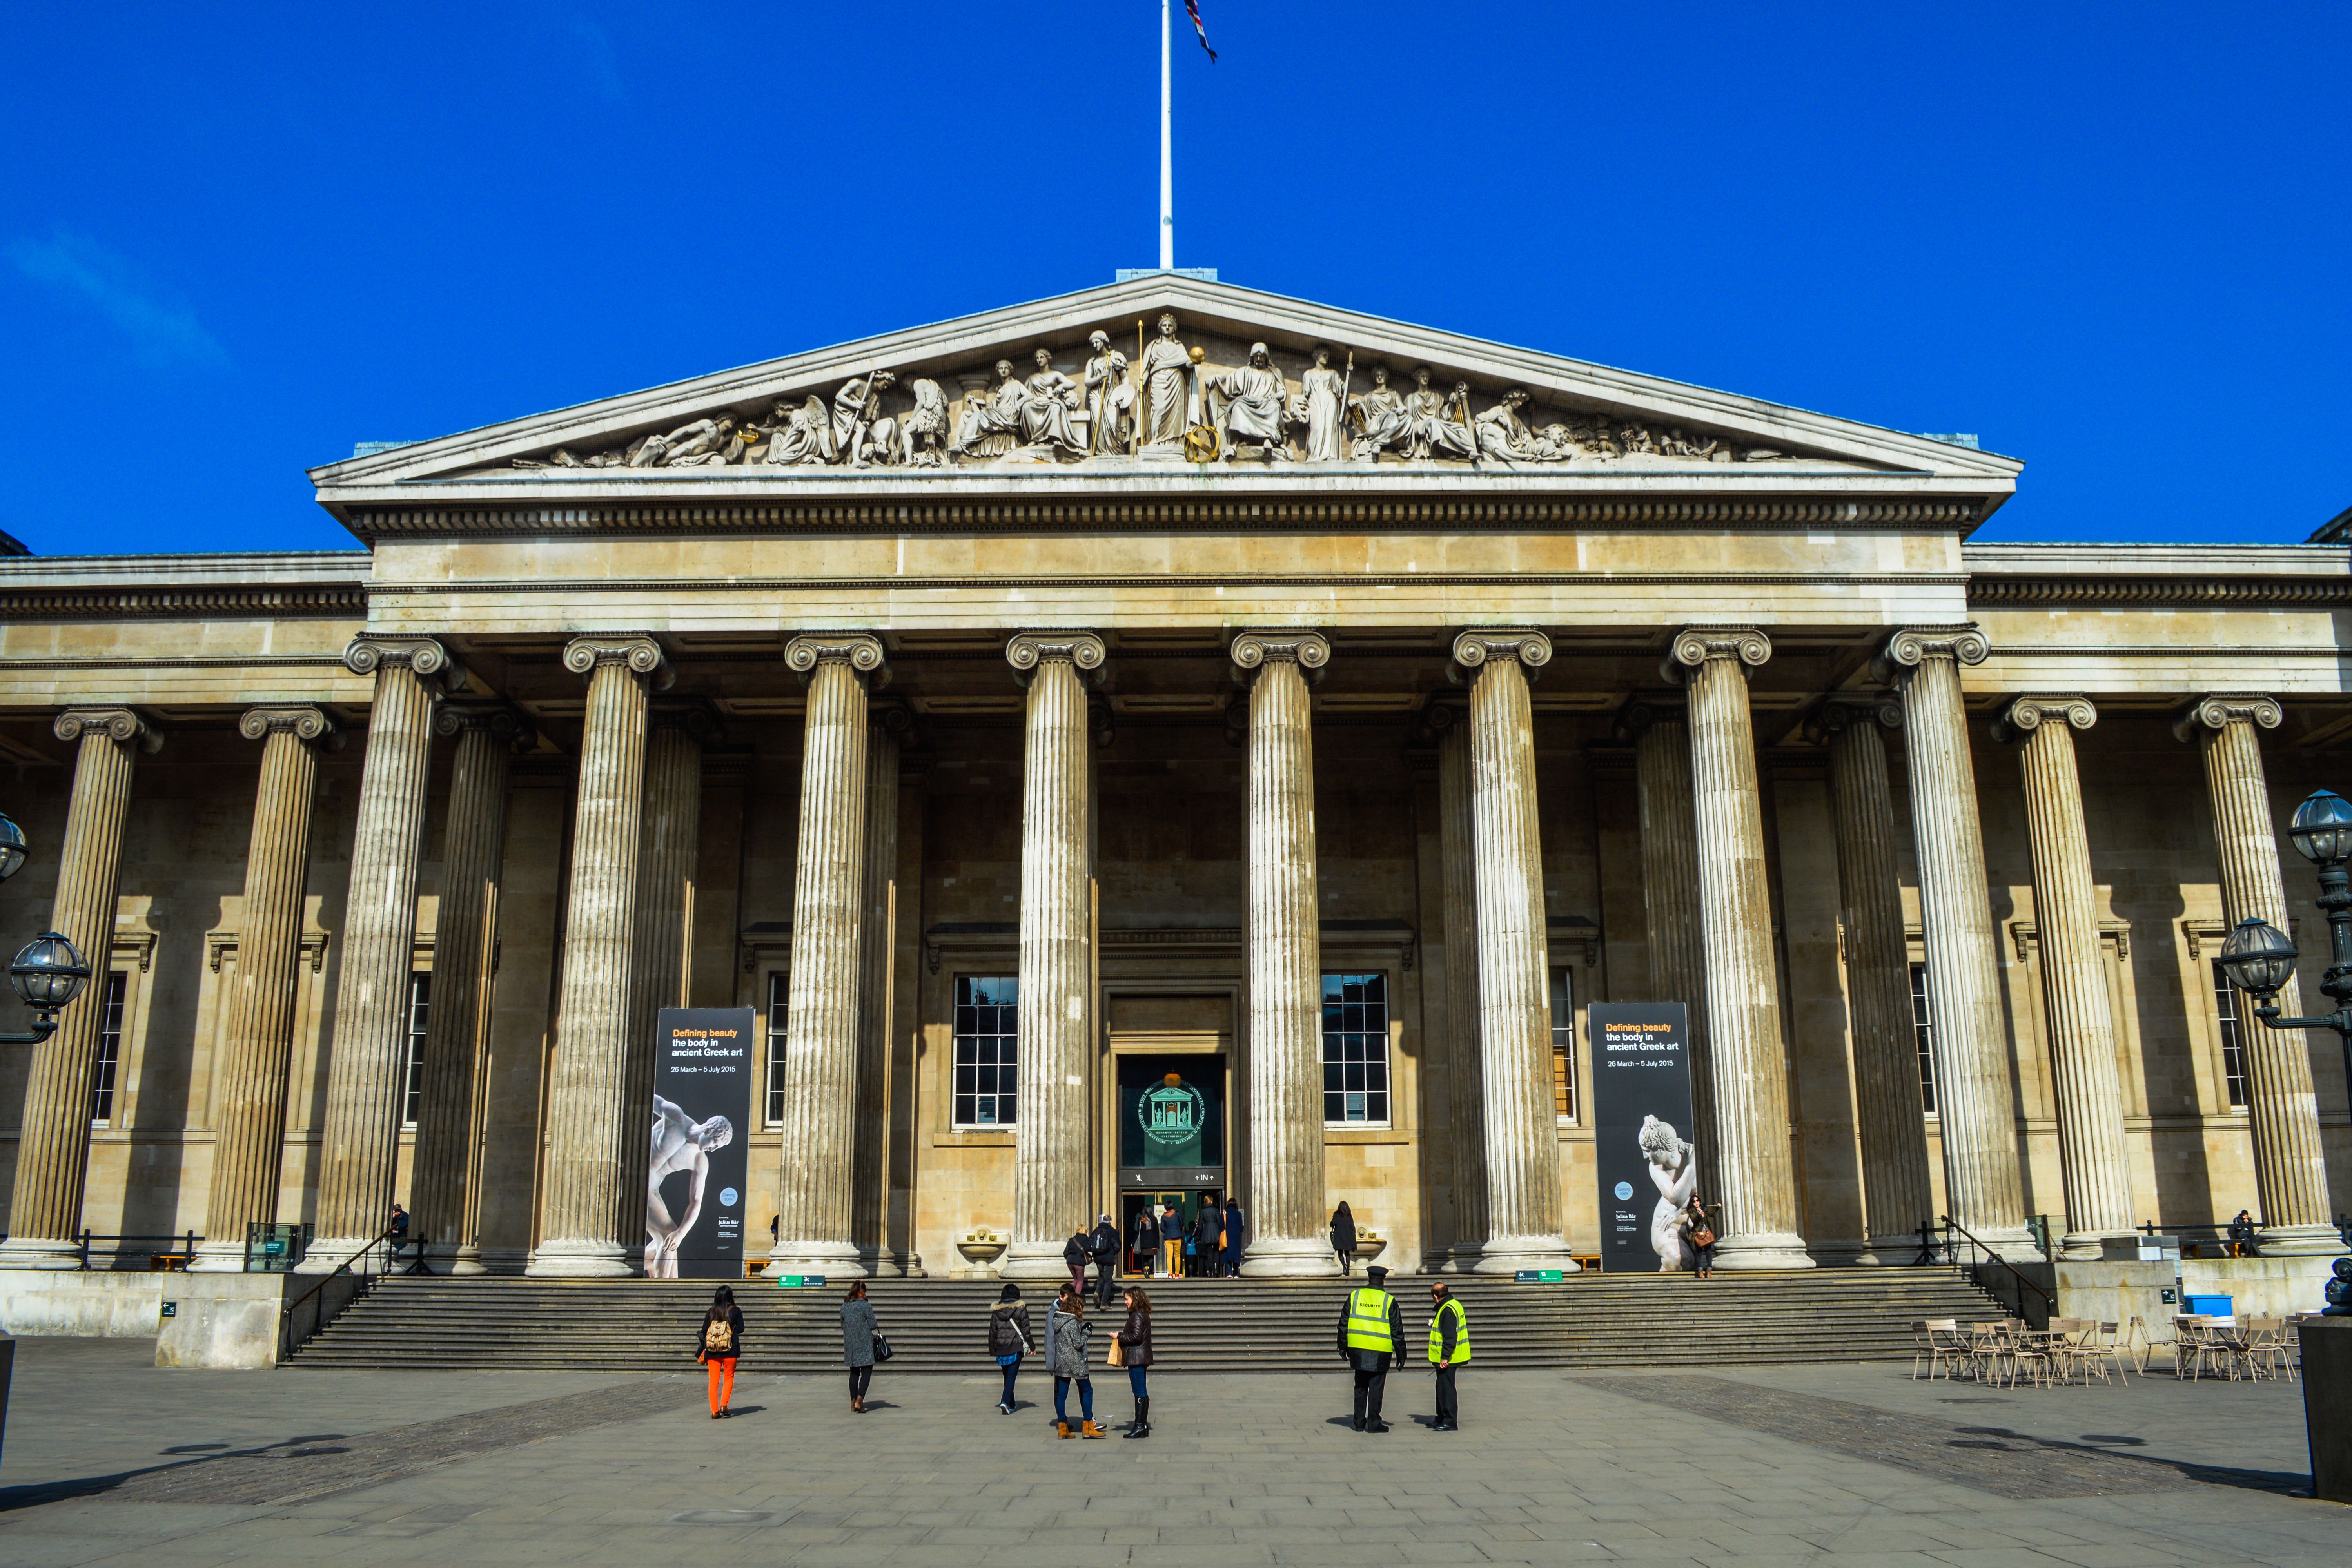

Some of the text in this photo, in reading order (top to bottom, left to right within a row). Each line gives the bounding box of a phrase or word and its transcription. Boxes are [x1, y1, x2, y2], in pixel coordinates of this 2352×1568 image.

[1606, 1023, 1671, 1033] Defining beauty
[673, 1029, 737, 1038] Defining beauty
[1622, 1033, 1643, 1042] body
[688, 1039, 708, 1048] body
[1607, 1042, 1637, 1051] ancient
[1639, 1042, 1665, 1051] Greek
[671, 1048, 702, 1056] ancient
